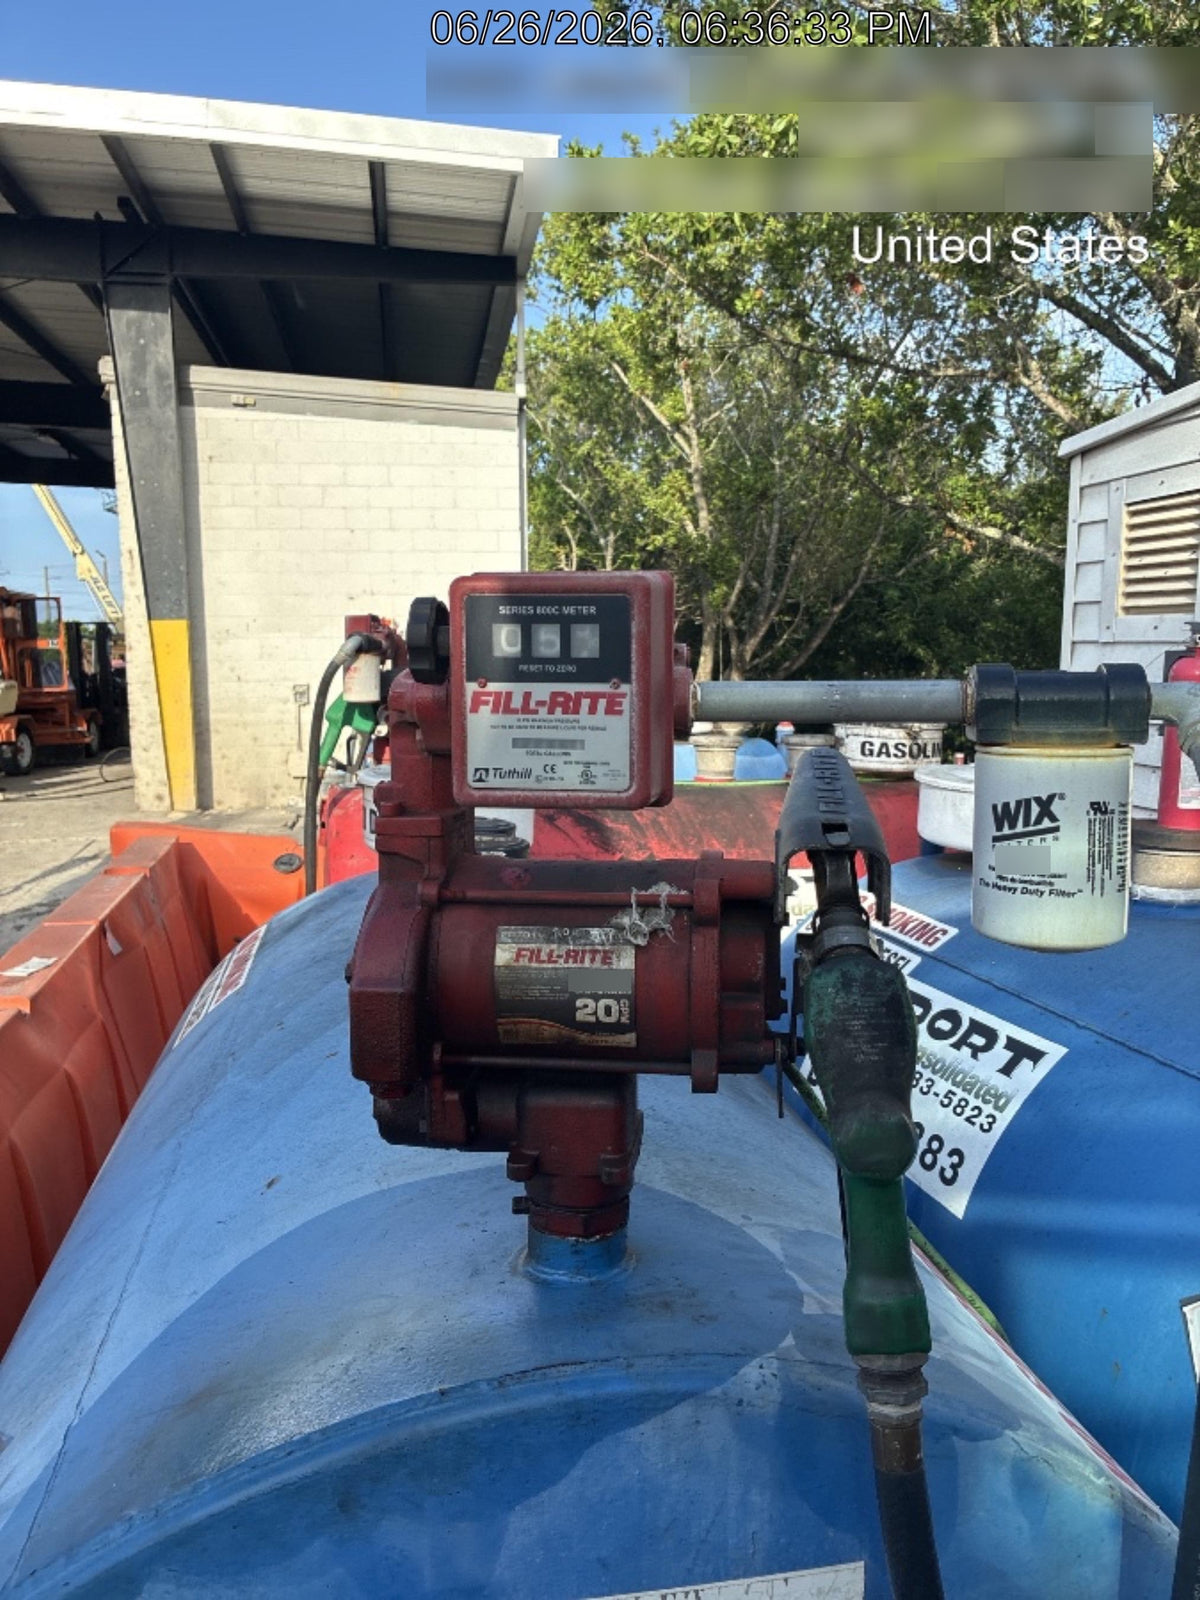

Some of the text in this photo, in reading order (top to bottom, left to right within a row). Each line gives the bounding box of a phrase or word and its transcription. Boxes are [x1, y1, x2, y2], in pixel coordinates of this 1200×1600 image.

[498, 605, 534, 616] SERIES
[562, 605, 597, 616] METER
[545, 664, 556, 673] TO
[469, 690, 627, 717] FILL-RITE
[492, 767, 533, 780] Tuthill
[992, 793, 1060, 833] WIX
[992, 881, 1018, 895] Heavy
[1020, 886, 1046, 898] Duty
[513, 947, 615, 966] FILL-RITE
[575, 998, 620, 1024] 20
